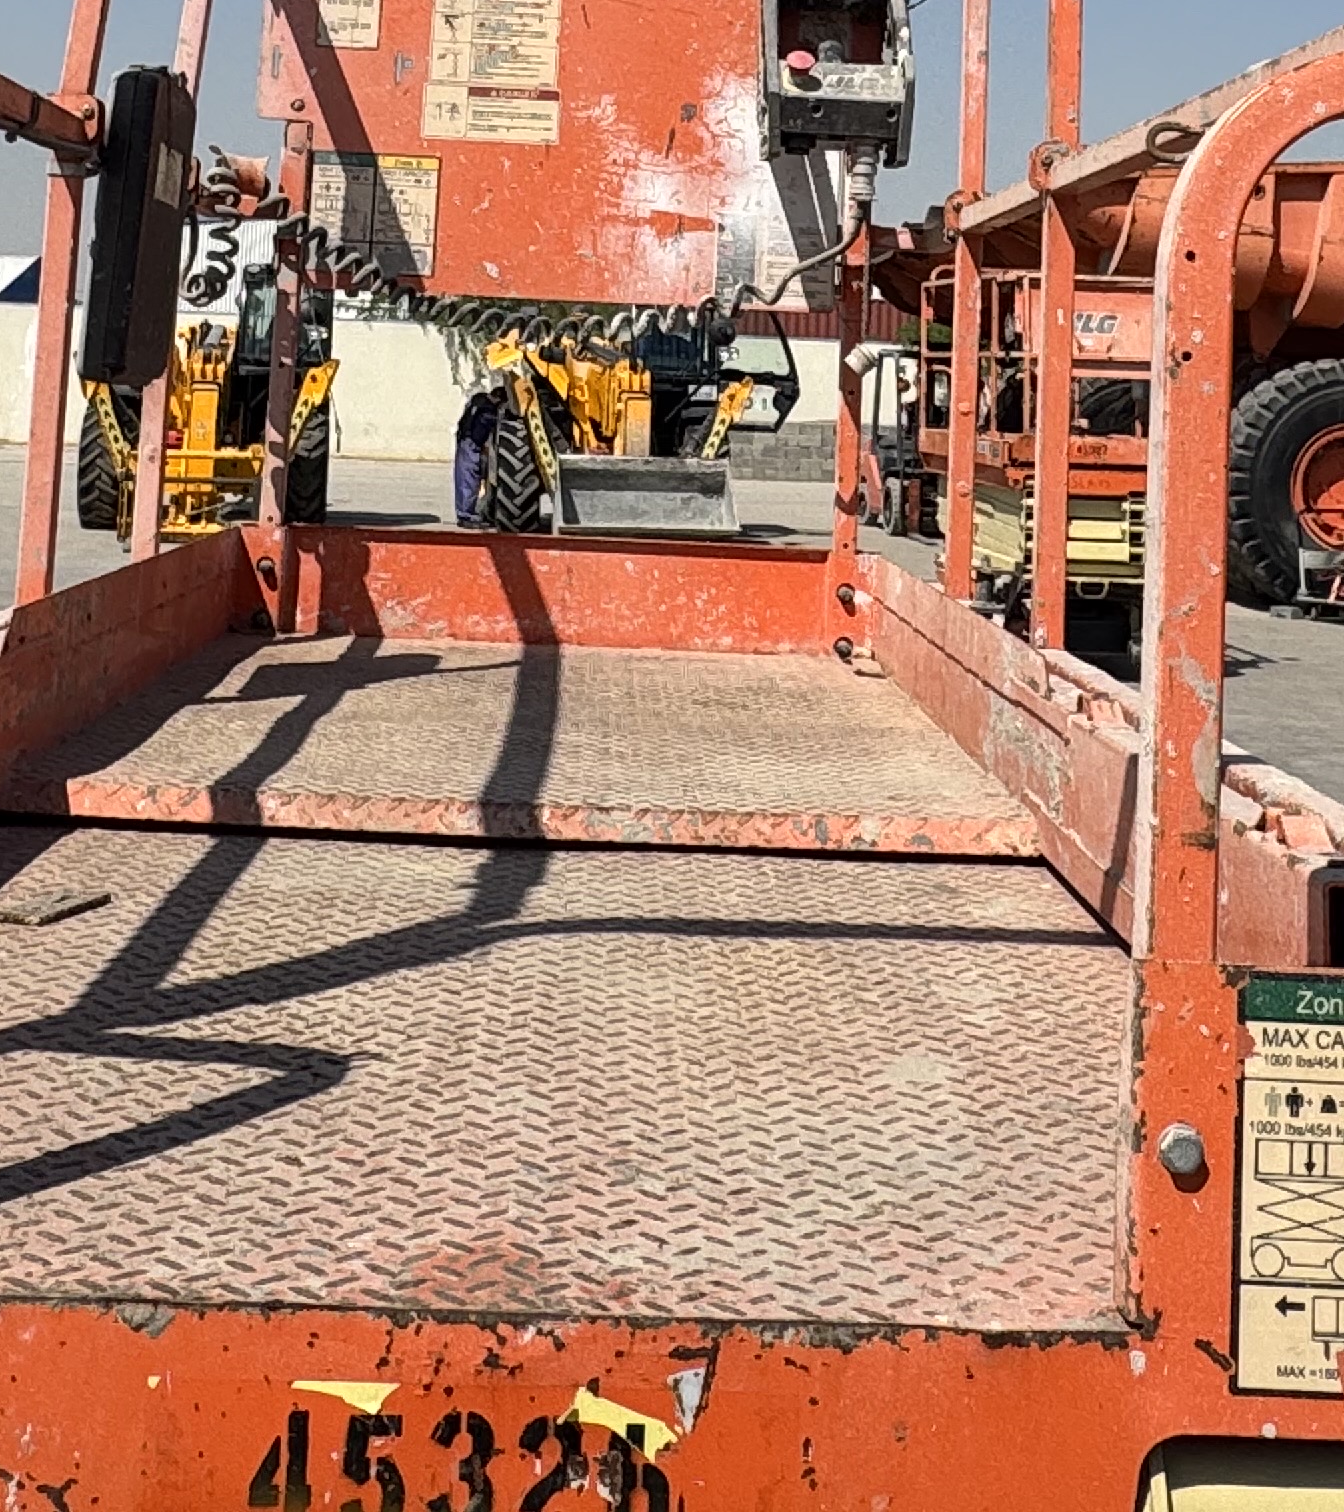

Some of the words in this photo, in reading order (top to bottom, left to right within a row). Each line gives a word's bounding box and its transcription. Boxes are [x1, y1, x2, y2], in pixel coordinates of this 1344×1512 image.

[1262, 1027, 1310, 1050] MAX
[1264, 1054, 1292, 1067] 1000
[1249, 1120, 1281, 1136] 1000
[1284, 1121, 1332, 1138] lbs/454
[1276, 1365, 1306, 1378] MAX
